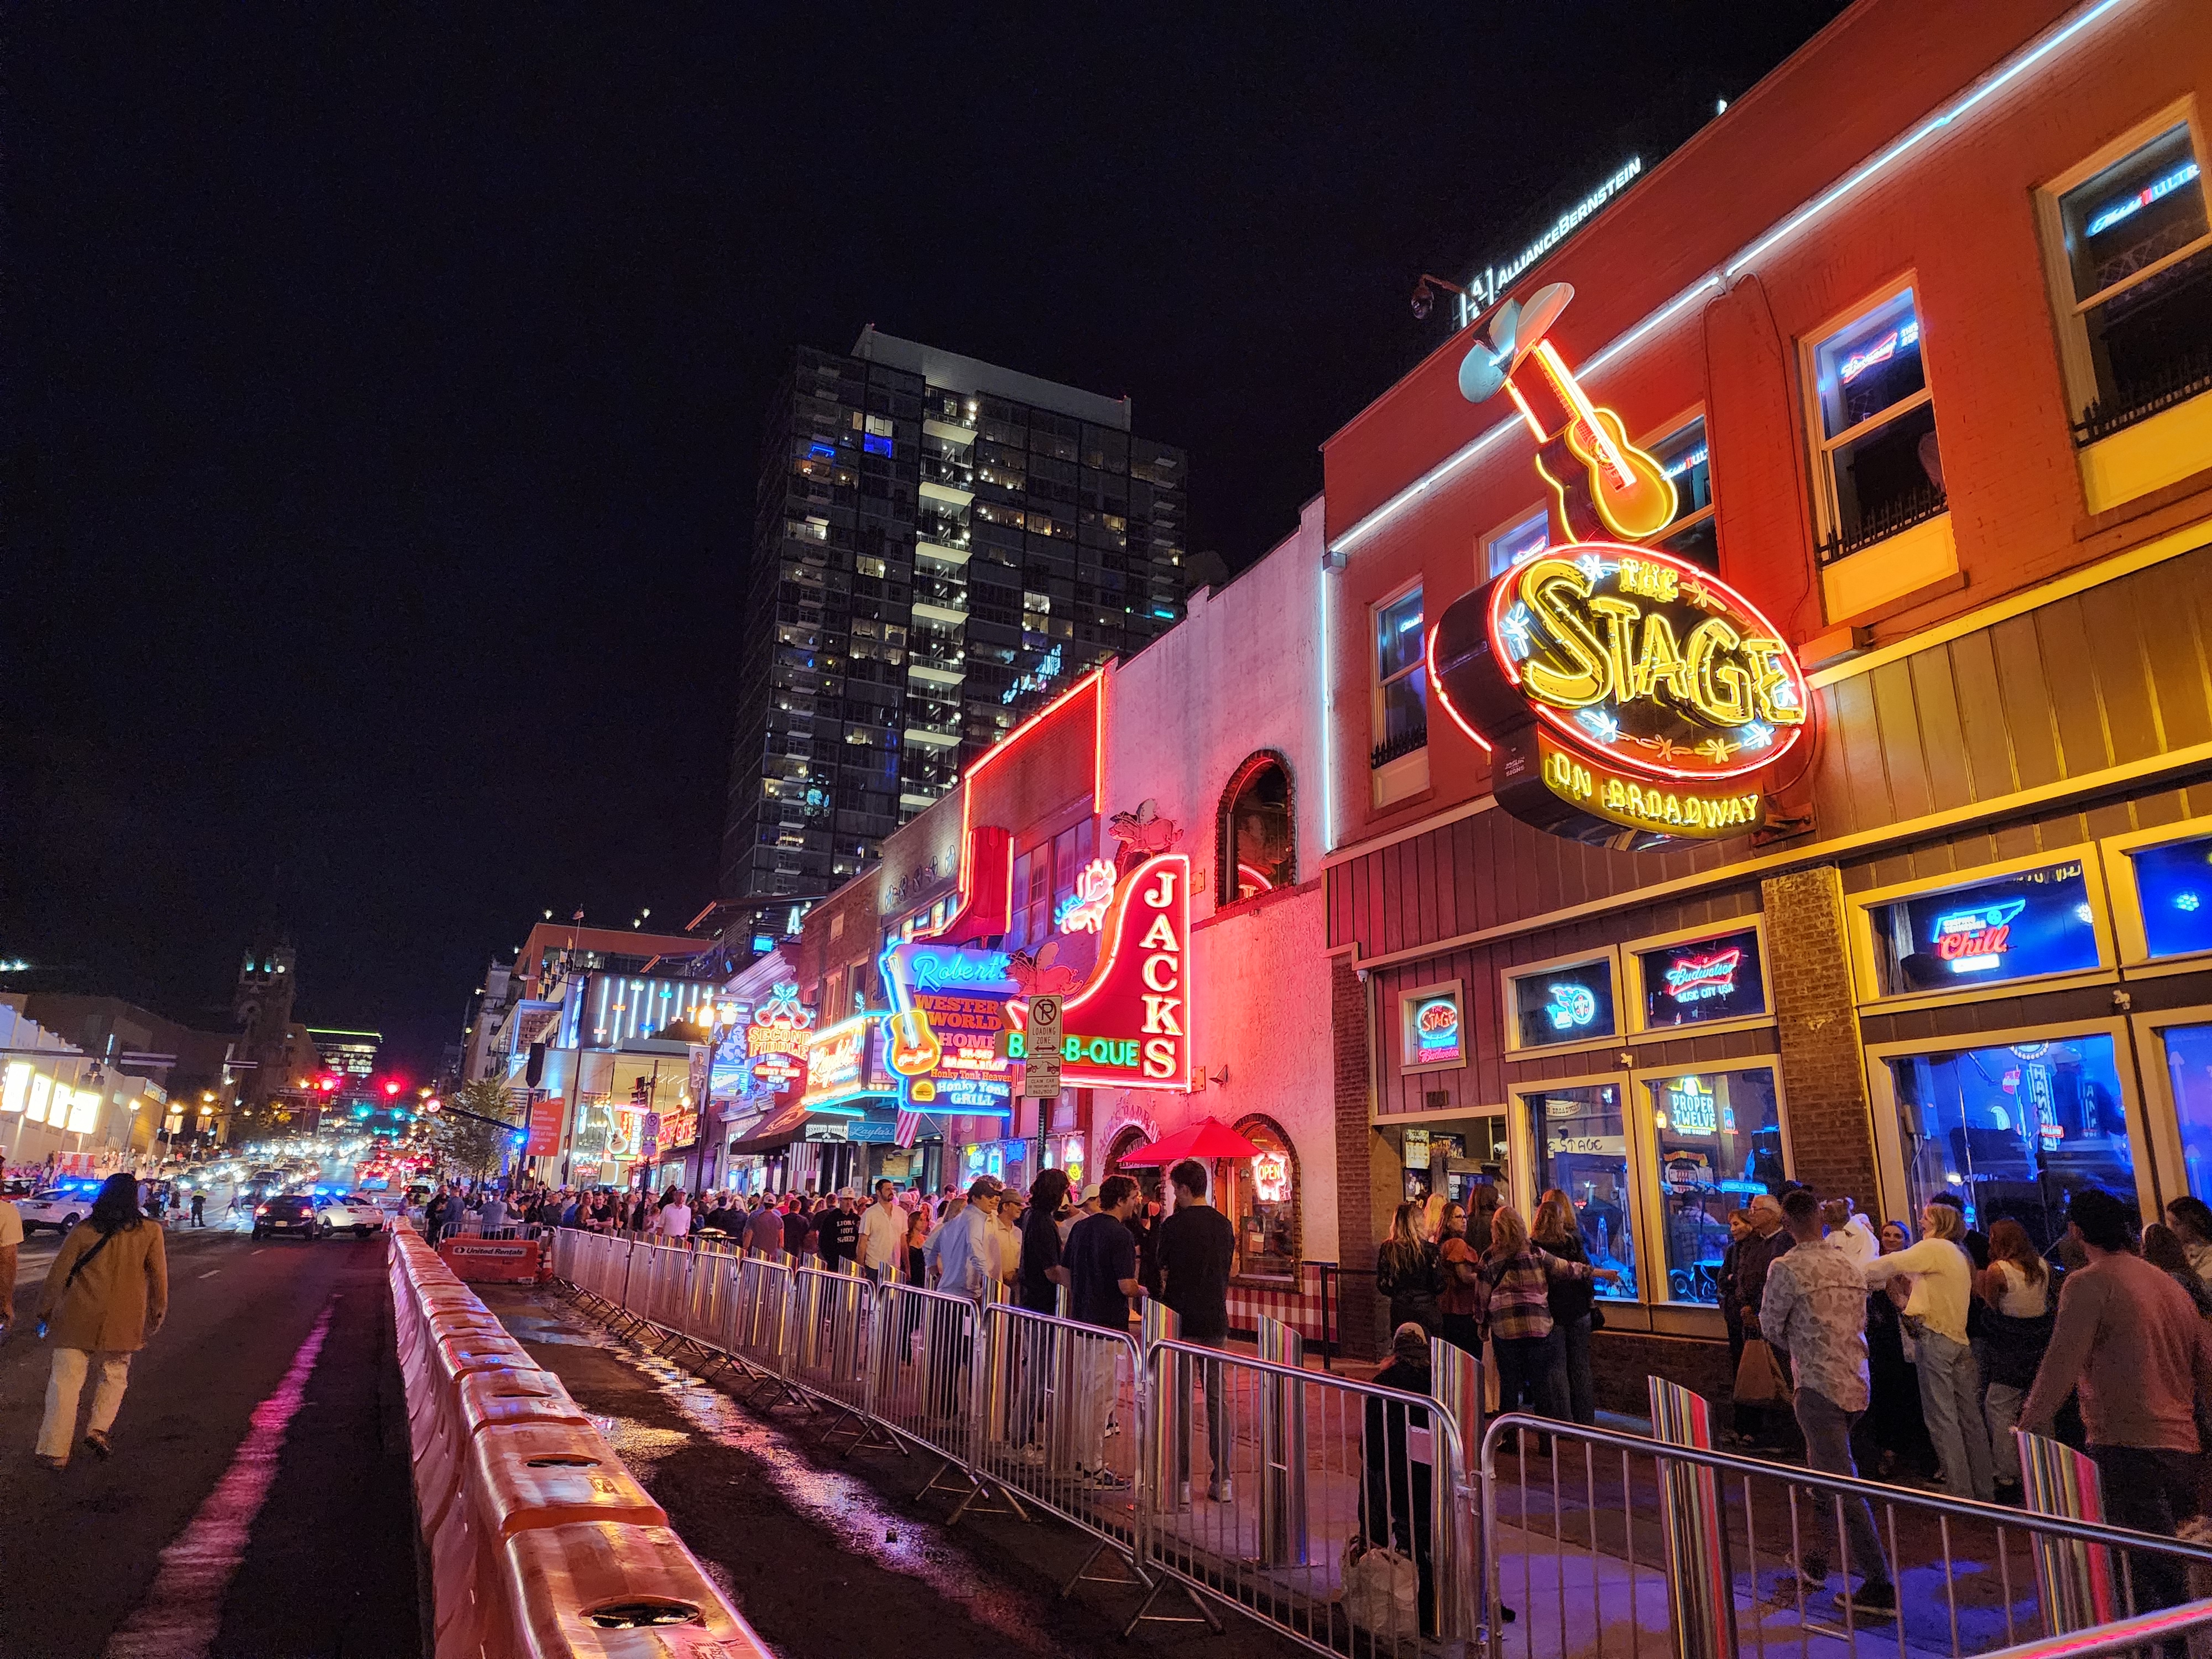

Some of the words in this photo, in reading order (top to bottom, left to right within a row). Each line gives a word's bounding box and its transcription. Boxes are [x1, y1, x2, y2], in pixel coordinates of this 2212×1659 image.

[1496, 156, 1641, 291] ALLIANCEBERNSTEIN
[1618, 557, 1679, 603] THE
[1519, 559, 1806, 725] STAGE
[1506, 765, 1525, 777] SIGNS
[1545, 752, 1592, 801] ON
[1600, 778, 1760, 829] BROADWAY
[1939, 925, 2009, 961] Chill
[1138, 870, 1184, 1078] JACKS
[1666, 963, 1735, 987] Budweiser
[1677, 991, 1699, 1004] MUSIC
[1700, 988, 1717, 999] CITY
[1718, 983, 1734, 995] USA
[926, 1011, 1003, 1030] WORLD
[1421, 1010, 1457, 1032] STAGE
[748, 1027, 812, 1046] SECOND
[1032, 1027, 1056, 1036] LOADING
[1036, 1036, 1051, 1045] ZONE
[749, 1041, 809, 1061] FIDDLE
[1008, 1032, 1139, 1067] B-B-QUE
[931, 1068, 958, 1080] Honky
[959, 1070, 980, 1081] Tonk
[982, 1072, 1013, 1082] Heaven
[936, 1079, 977, 1093] Honky
[978, 1081, 1010, 1098] Tonk
[950, 1092, 995, 1106] GRILL
[1672, 1094, 1714, 1114] PROPER
[1672, 1110, 1717, 1128] TWELVE
[849, 1125, 894, 1139] Layla's
[1561, 1138, 1603, 1152] STAGE
[1258, 1164, 1281, 1181] OPEN
